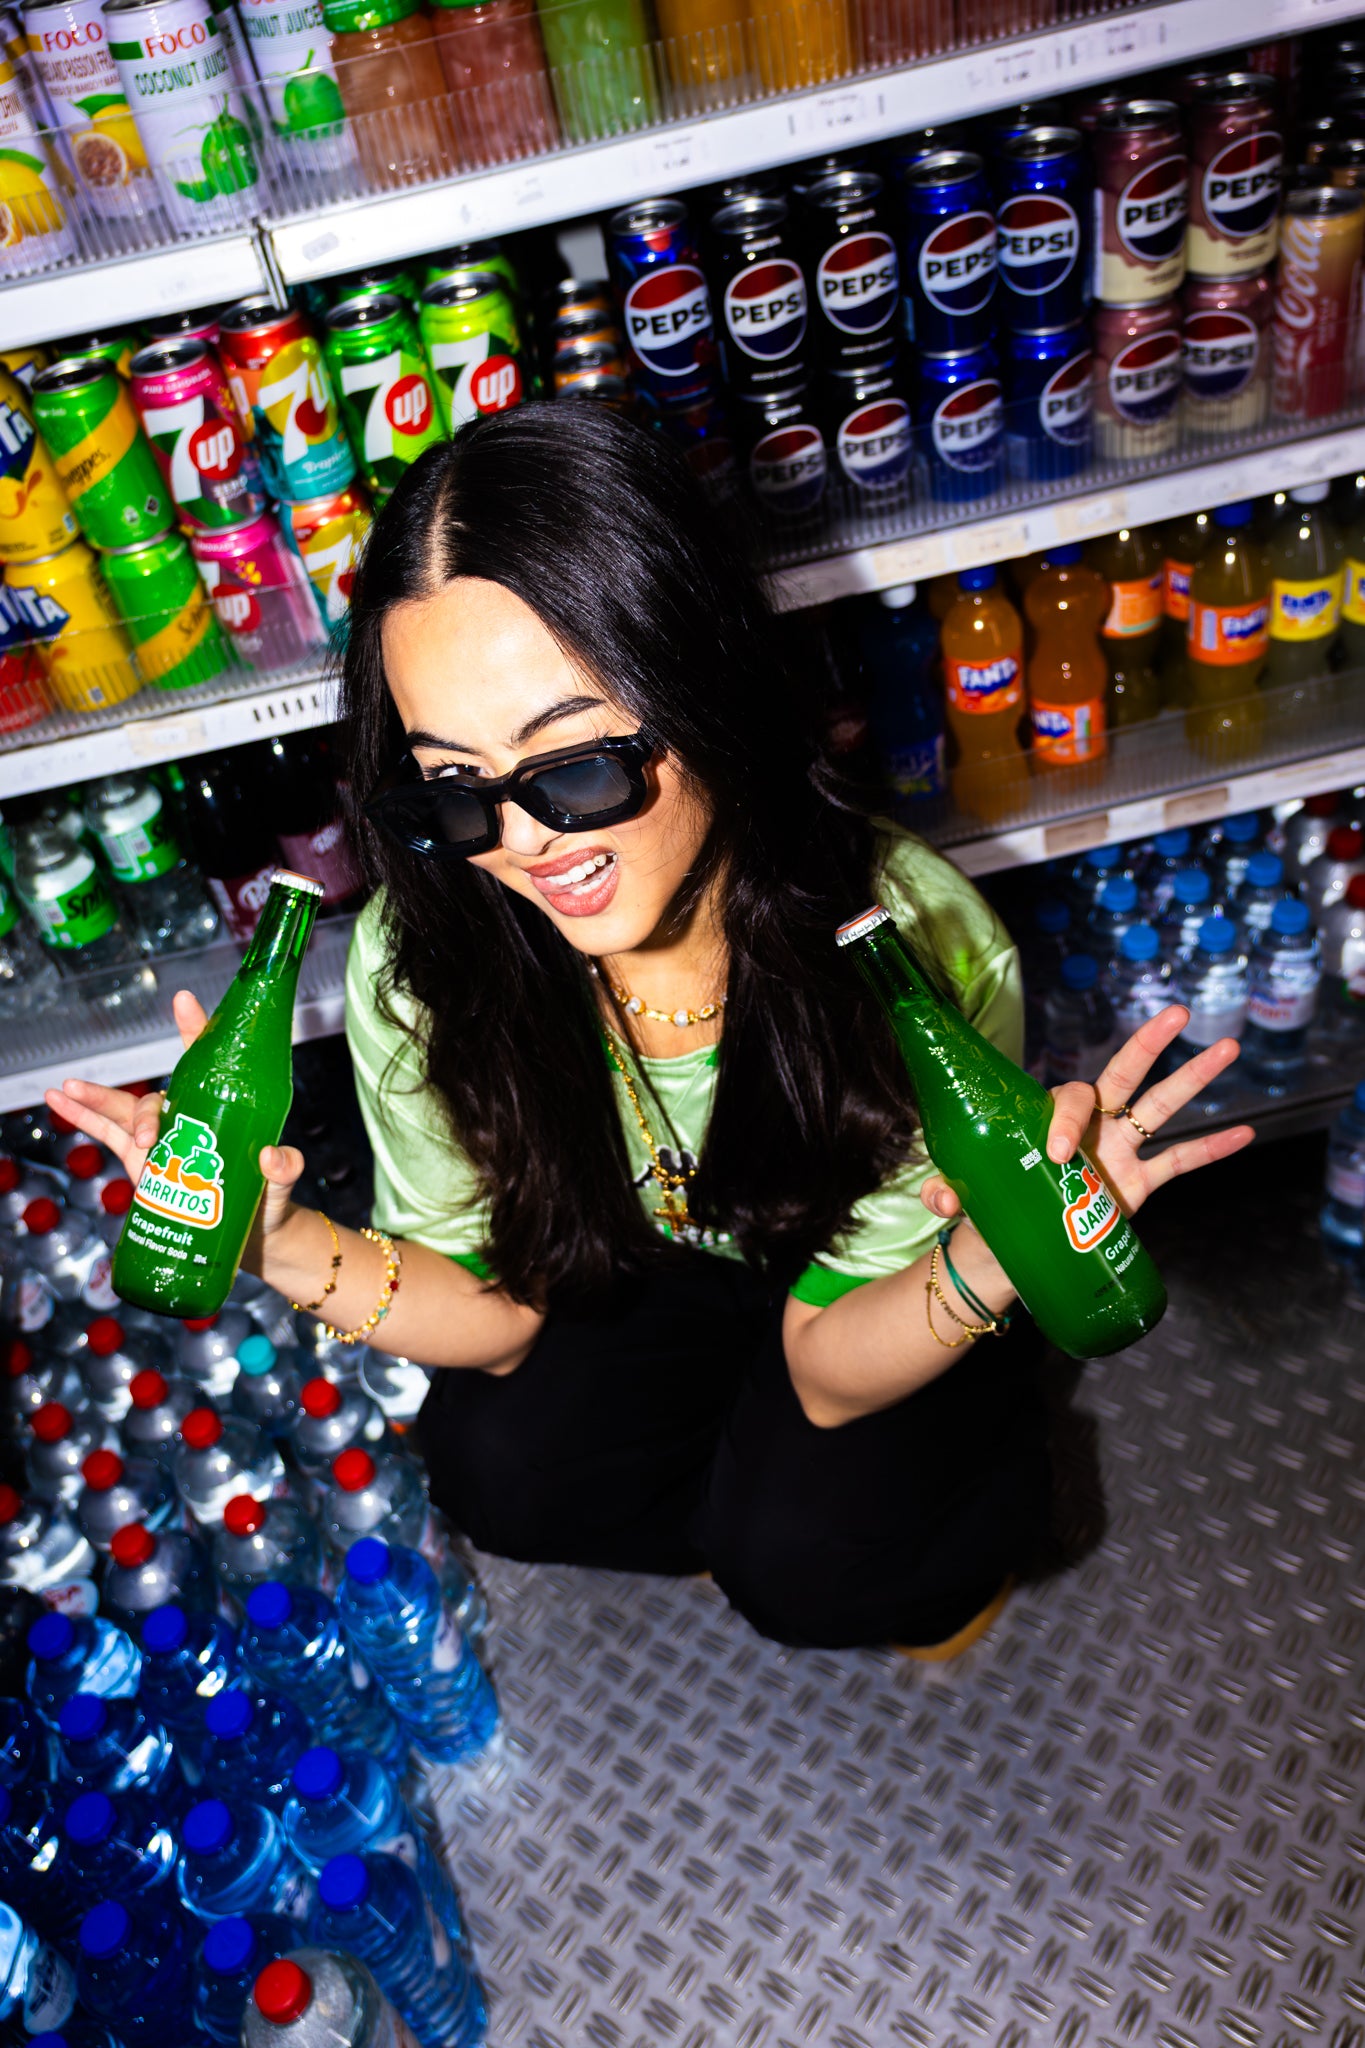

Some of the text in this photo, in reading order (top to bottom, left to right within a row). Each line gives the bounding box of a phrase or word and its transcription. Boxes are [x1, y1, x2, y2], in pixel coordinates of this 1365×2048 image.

[44, 21, 103, 52] FOCO
[145, 22, 206, 58] FOCO
[134, 61, 200, 95] COCONUT
[1208, 166, 1281, 200] PEPS
[1125, 192, 1187, 226] PEP
[926, 243, 994, 281] PEPS
[823, 265, 895, 298] PEPS
[731, 290, 801, 327] PEPS
[843, 431, 908, 460] PEPS
[755, 452, 823, 484] PEPS
[138, 1172, 211, 1216] JARRITOS
[131, 1211, 194, 1247] Grapefruit
[145, 1237, 167, 1254] Flavor
[166, 1246, 188, 1261] Soda
